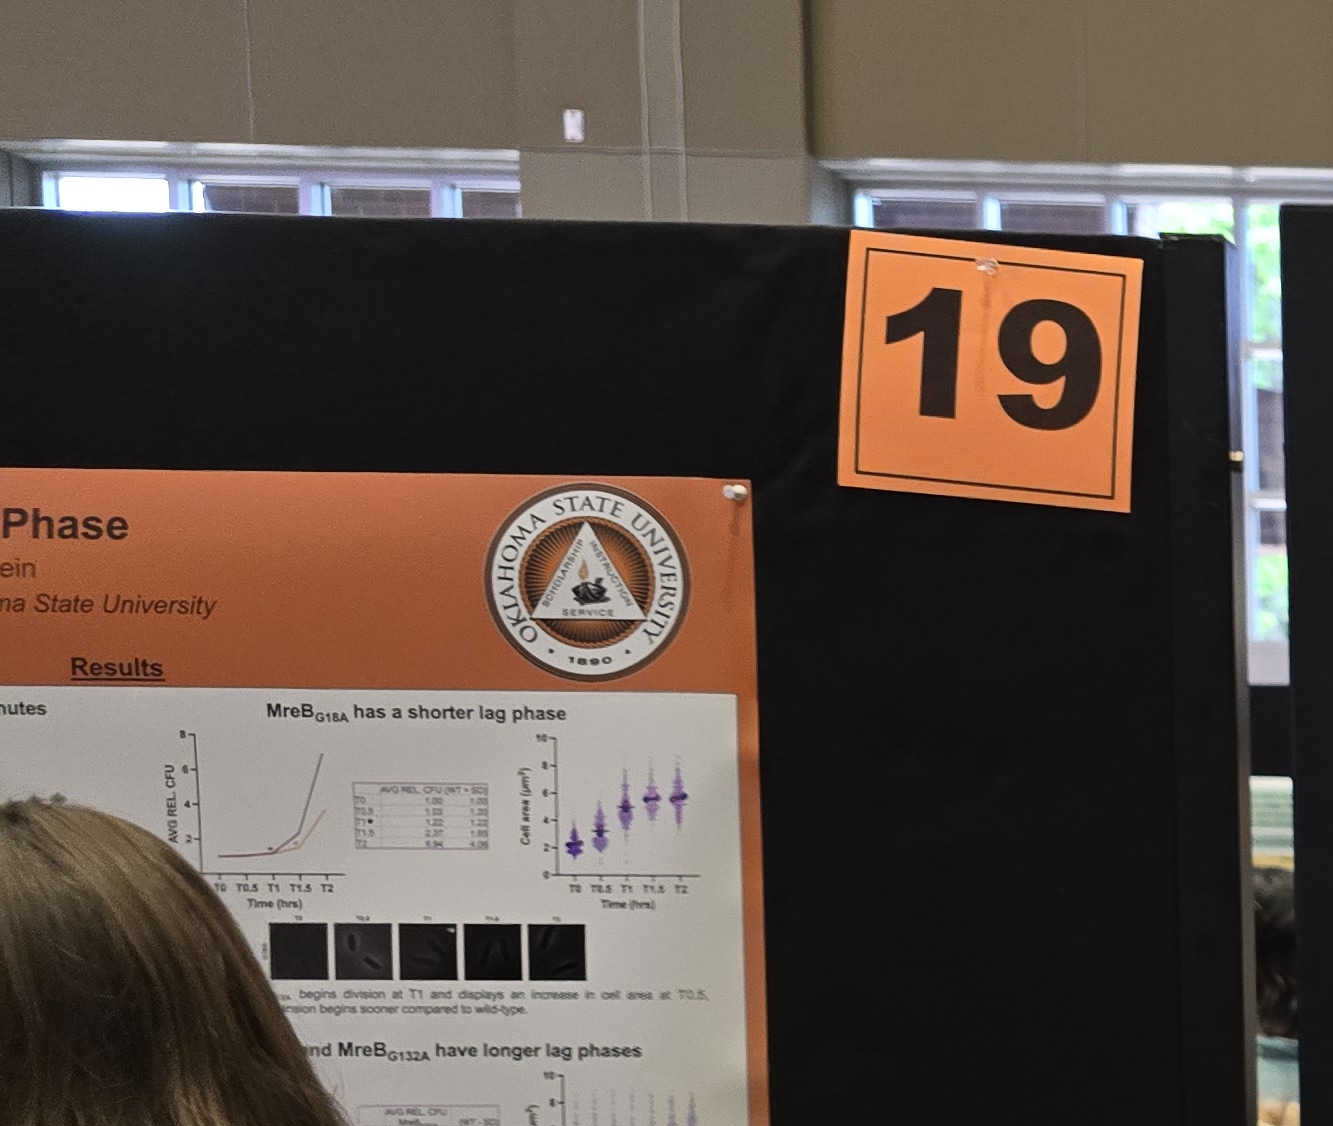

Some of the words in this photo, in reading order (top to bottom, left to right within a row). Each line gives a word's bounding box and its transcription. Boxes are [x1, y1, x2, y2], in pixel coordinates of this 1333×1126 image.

[884, 287, 1103, 432] 19
[2, 507, 129, 540] Phase
[498, 513, 547, 643] OKLAHOMA
[553, 495, 625, 519] STATE
[630, 512, 678, 644] UNIVERSITY
[33, 593, 95, 614] State
[103, 593, 218, 620] University
[70, 657, 165, 679] Results
[568, 655, 613, 666] 1890
[352, 703, 387, 720] has
[391, 707, 403, 720] a
[406, 704, 475, 720] shorter
[478, 704, 507, 725] lag
[511, 705, 567, 724] phase
[434, 1042, 478, 1058] have
[482, 1042, 542, 1061] longer
[544, 1043, 573, 1062] lag
[577, 1043, 643, 1062] phases
